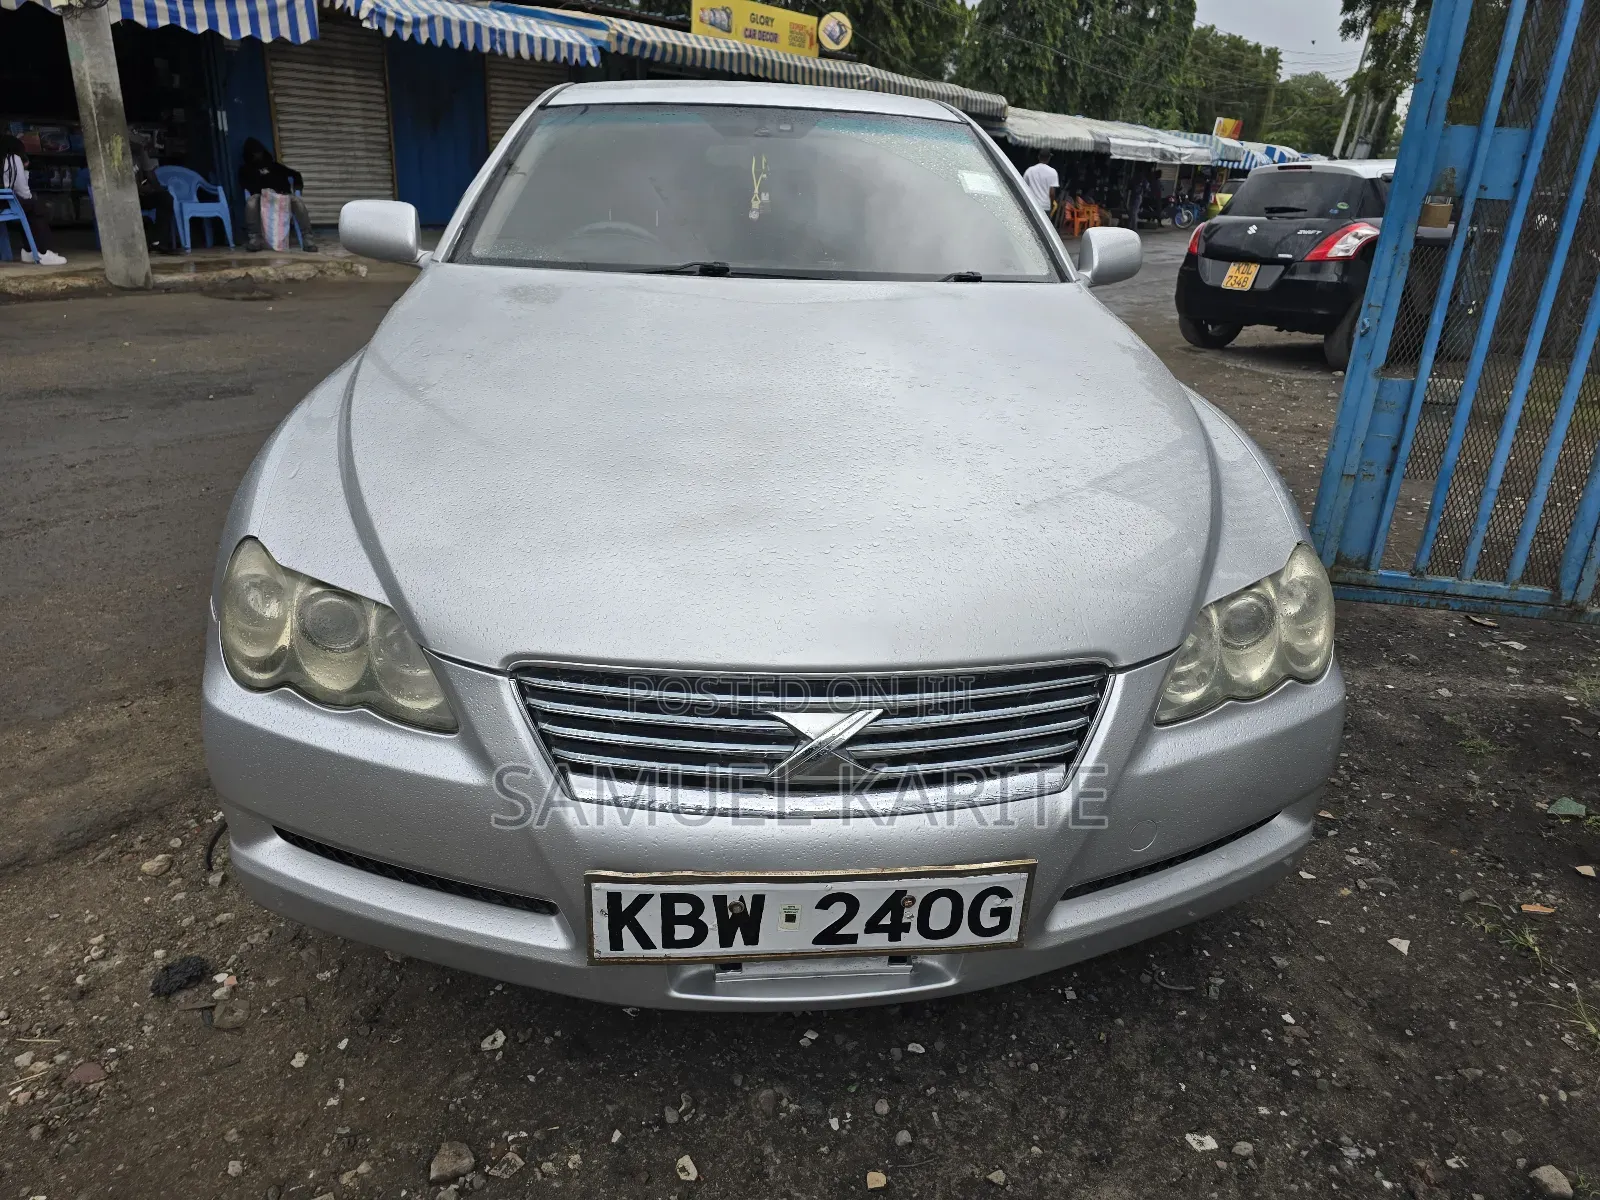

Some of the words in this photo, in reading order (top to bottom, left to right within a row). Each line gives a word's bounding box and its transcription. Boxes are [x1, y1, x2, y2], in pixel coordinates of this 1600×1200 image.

[749, 13, 775, 27] GLORY
[744, 27, 757, 40] CAR
[757, 29, 779, 43] DECOR
[1225, 275, 1249, 288] 734B
[606, 890, 766, 952] KBW
[811, 885, 1014, 945] 240G
